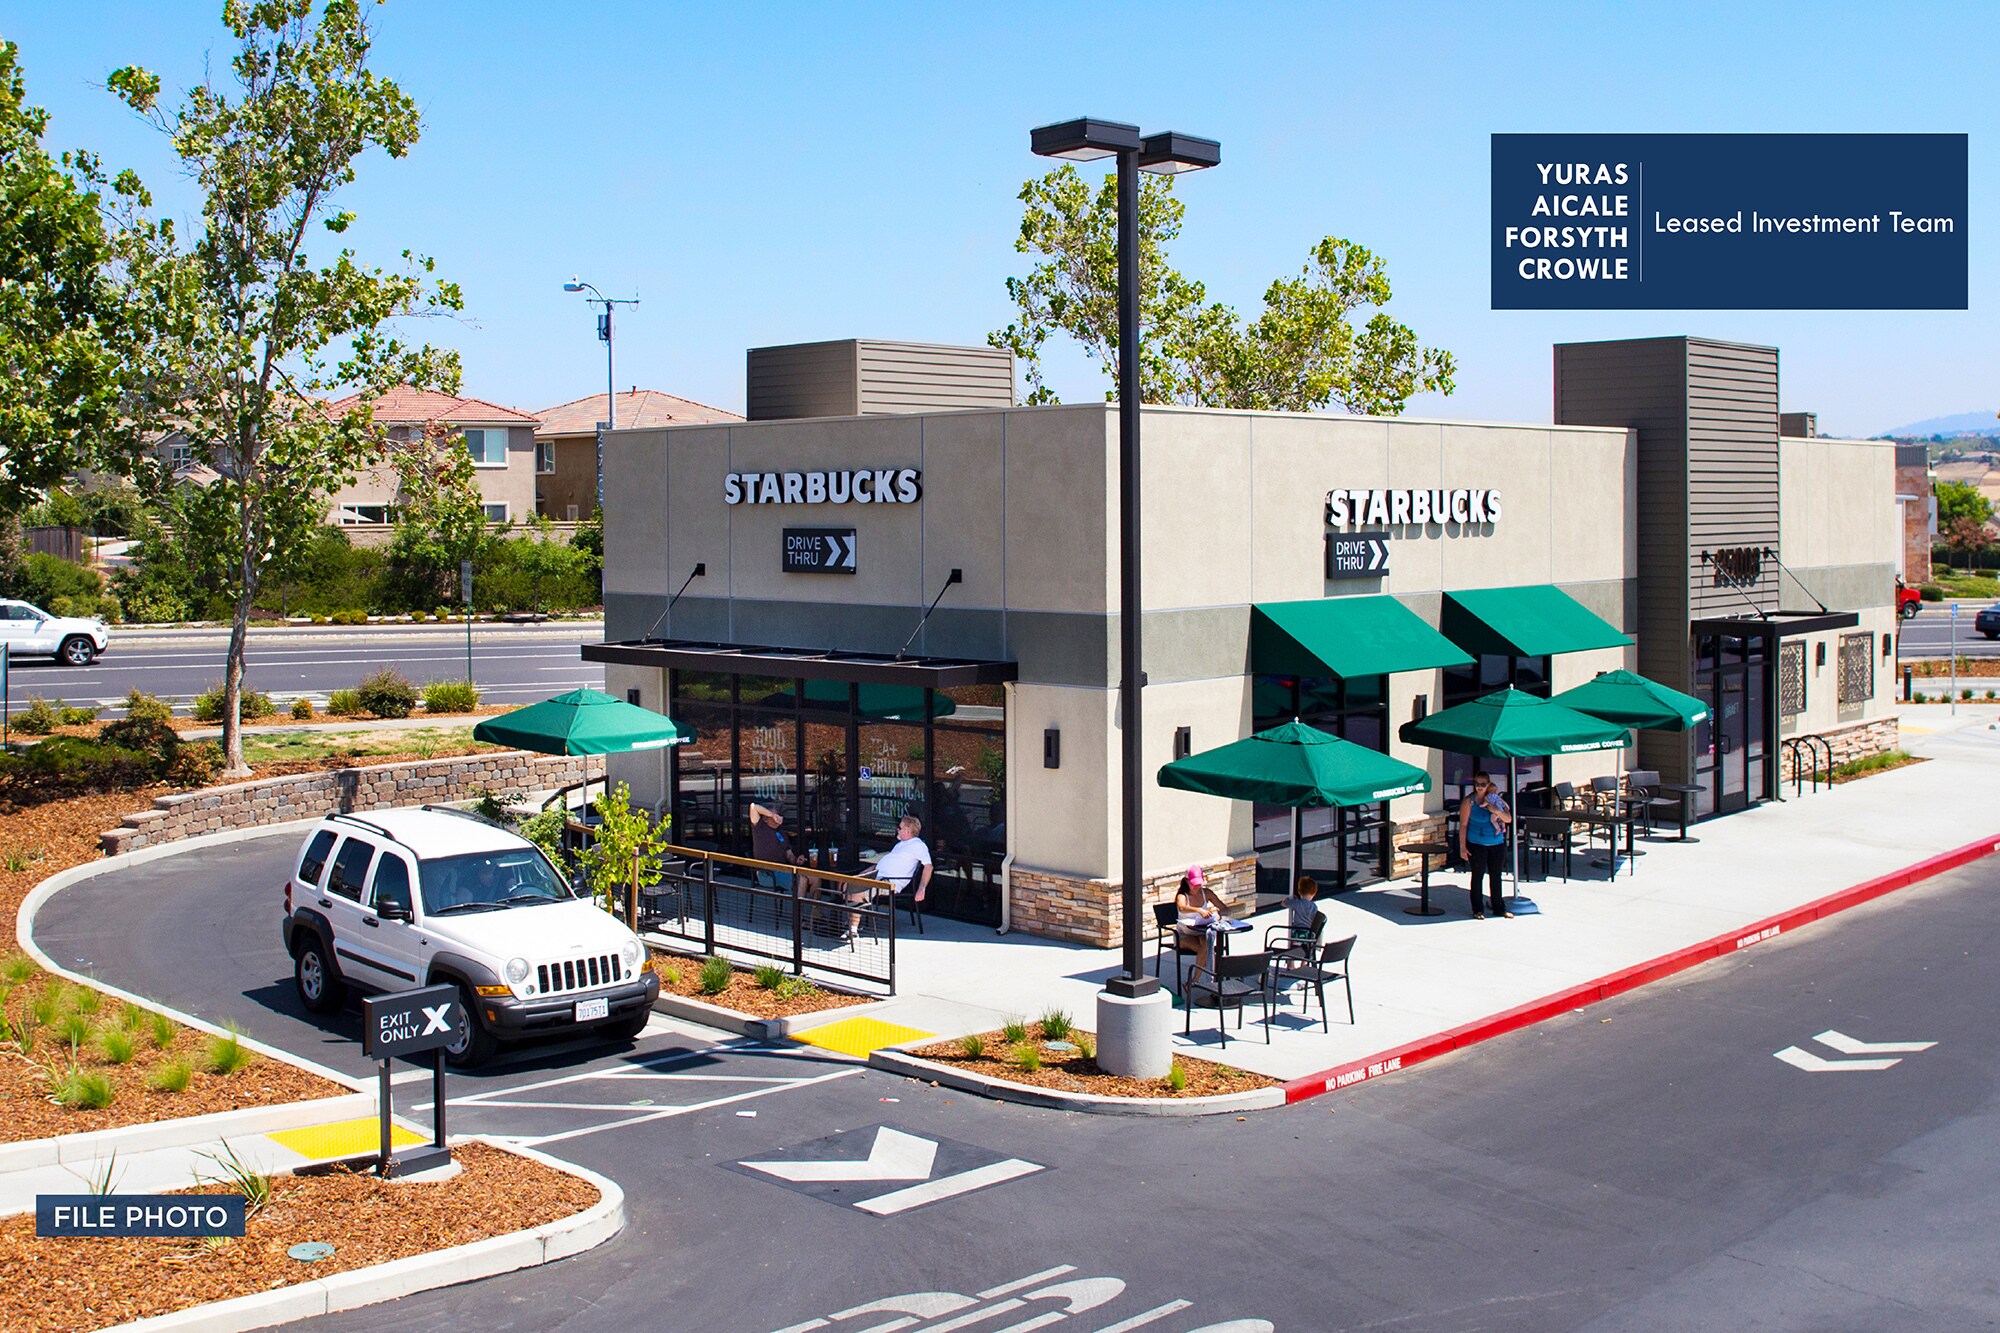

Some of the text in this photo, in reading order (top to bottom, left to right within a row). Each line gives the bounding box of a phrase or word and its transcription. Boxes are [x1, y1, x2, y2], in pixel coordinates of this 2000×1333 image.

[724, 469, 919, 505] STARBUCKS
[1330, 489, 1502, 527] STARBUCKS
[787, 536, 821, 551] DRIVE
[1336, 541, 1366, 555] DRIVE
[788, 551, 819, 566] THRU
[1336, 557, 1364, 571] THRU
[1561, 741, 1601, 752] STARBUCKS
[1372, 786, 1406, 799] STARBUCKS
[380, 1010, 412, 1030] EXIT
[380, 1024, 420, 1044] ONLY
[1325, 1057, 1401, 1091] NO PARKING FIRE LANE
